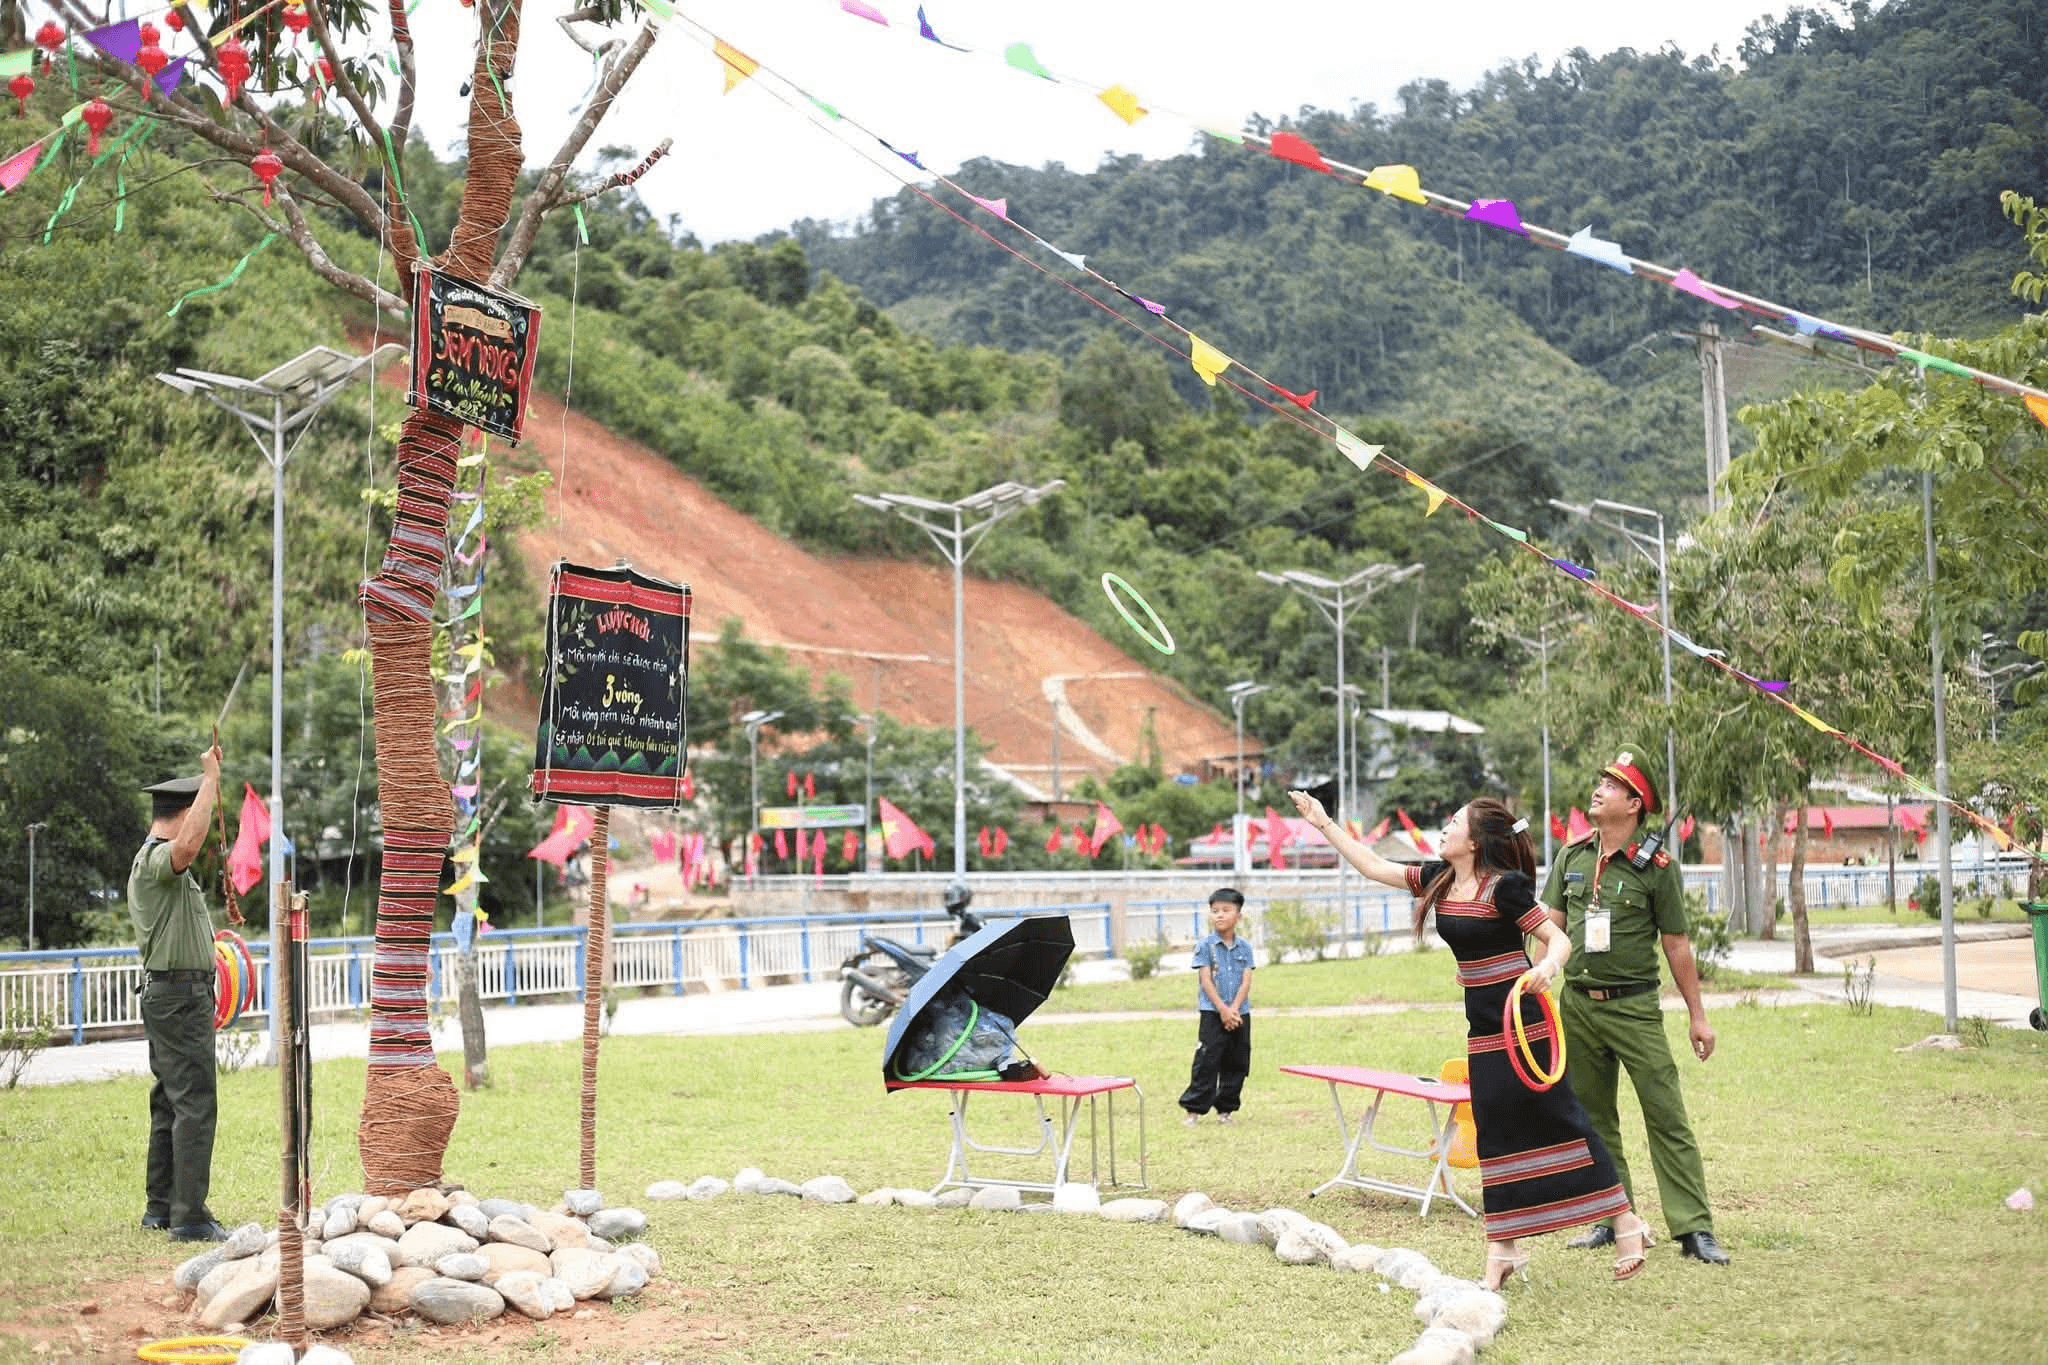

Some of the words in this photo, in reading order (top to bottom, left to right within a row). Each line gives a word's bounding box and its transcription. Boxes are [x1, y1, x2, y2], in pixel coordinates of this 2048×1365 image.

[567, 645, 586, 663] Mỗi
[586, 648, 606, 672] người
[608, 649, 620, 664] chơi
[622, 652, 634, 667] sẽ
[632, 654, 652, 673] được
[652, 659, 668, 677] nhận
[602, 673, 616, 708] 3
[615, 677, 644, 715] vòng
[562, 700, 580, 720] Mỗi
[582, 706, 599, 730] vòng
[600, 708, 618, 721] ném
[621, 709, 636, 726] vào
[640, 712, 665, 731] nhánh
[665, 712, 680, 736] quế
[567, 729, 585, 751] nhận
[596, 729, 607, 746] túi
[608, 729, 625, 751] quế
